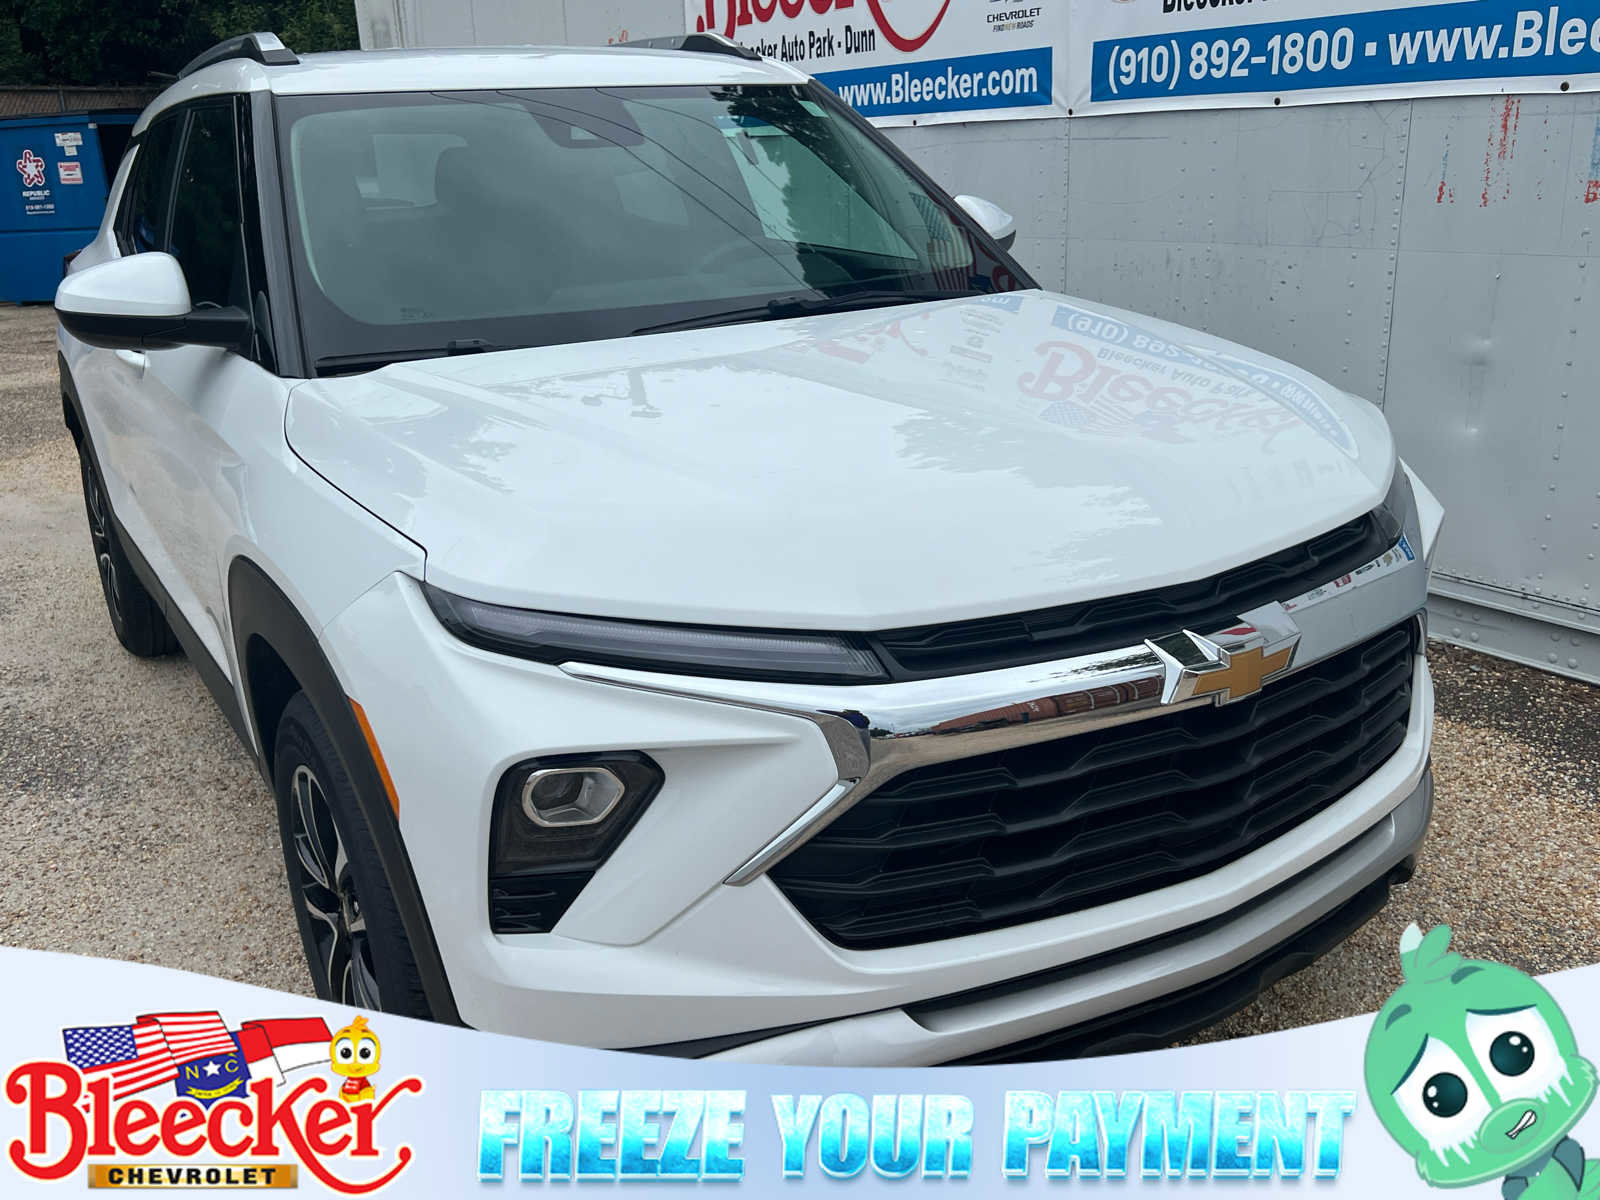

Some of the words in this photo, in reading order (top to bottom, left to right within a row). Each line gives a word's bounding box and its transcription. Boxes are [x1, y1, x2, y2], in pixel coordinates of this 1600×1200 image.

[986, 8, 1042, 23] CHEVROLET
[781, 34, 805, 62] Auto
[808, 28, 835, 59] Park
[844, 25, 876, 53] Dunn
[1108, 38, 1181, 93] (910)
[1189, 27, 1354, 80] 892-1800
